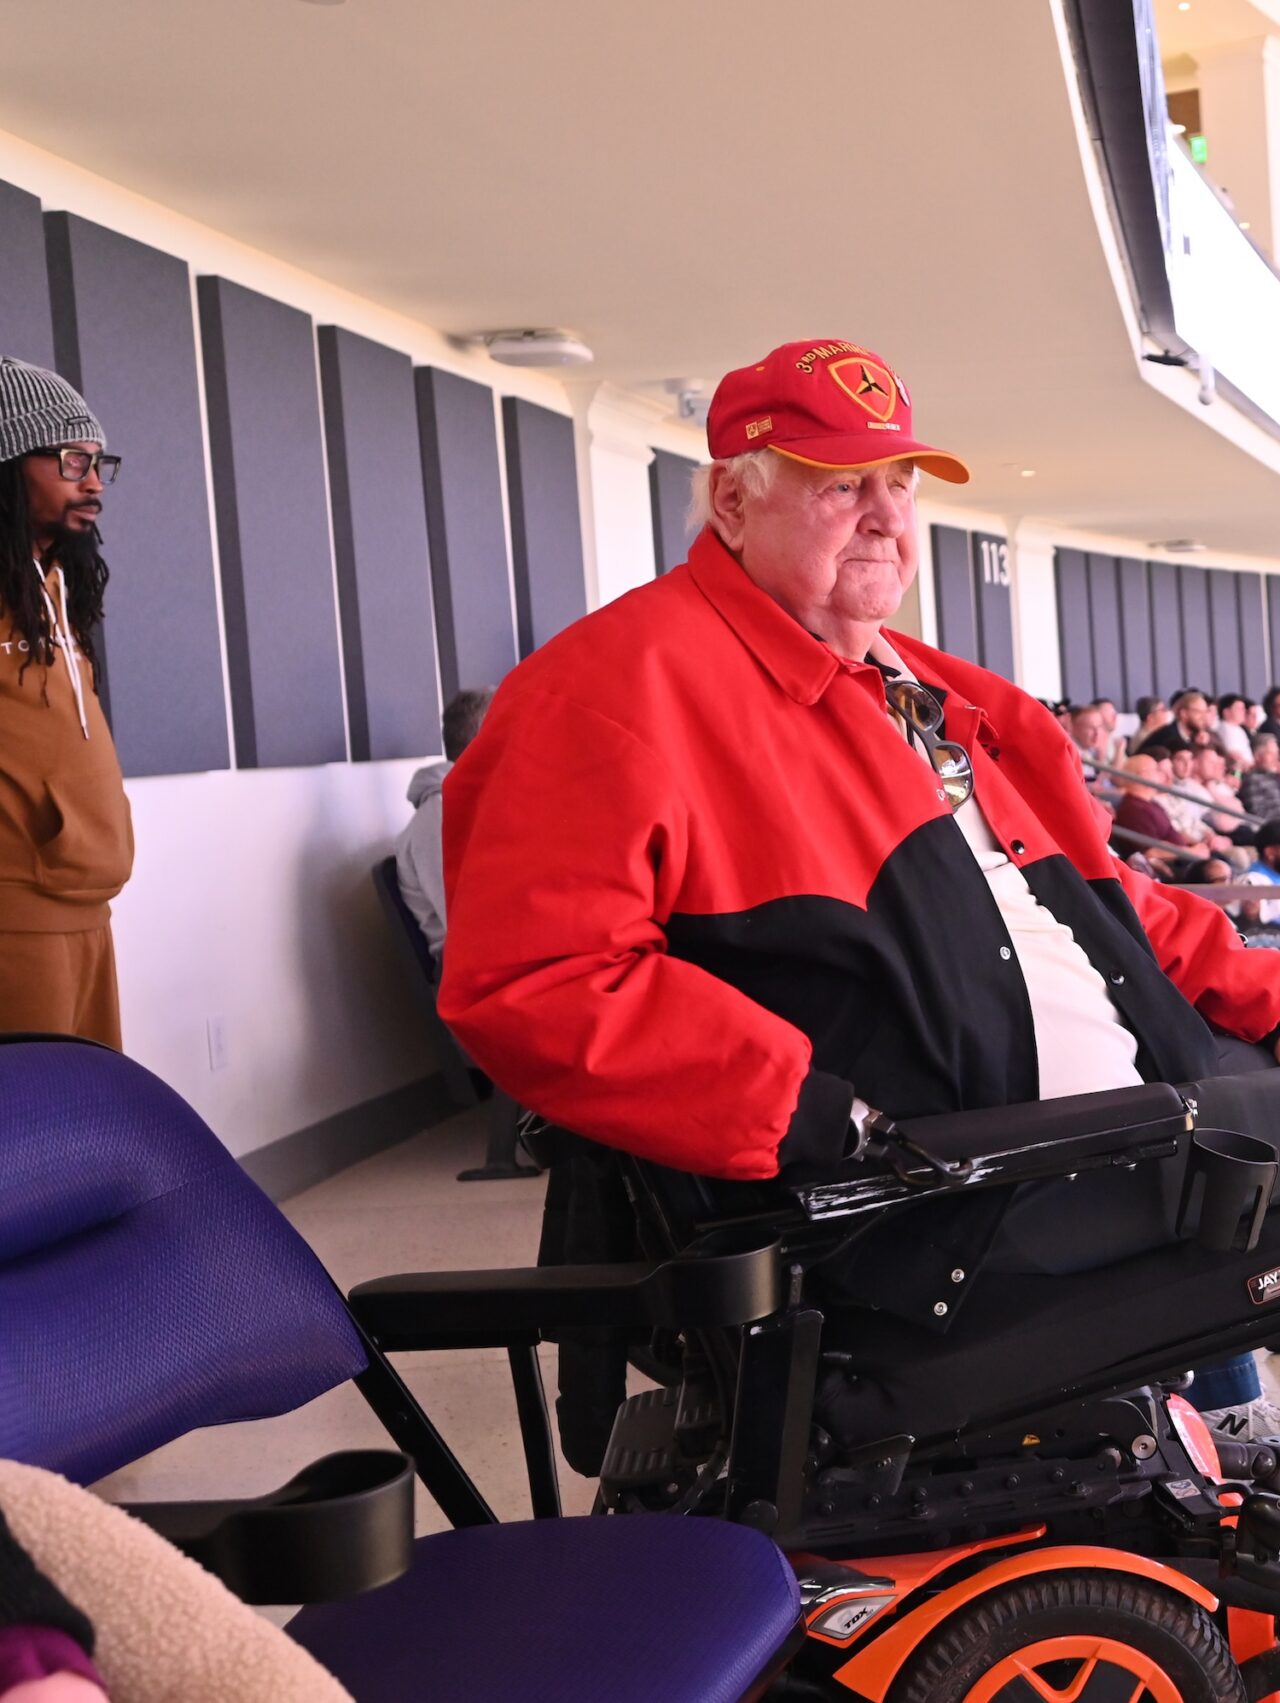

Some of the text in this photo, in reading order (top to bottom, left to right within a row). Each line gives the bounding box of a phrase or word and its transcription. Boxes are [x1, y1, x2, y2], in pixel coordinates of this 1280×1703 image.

[981, 541, 1010, 587] 113
[1257, 1271, 1278, 1290] JAY
[1215, 1412, 1248, 1436] N
